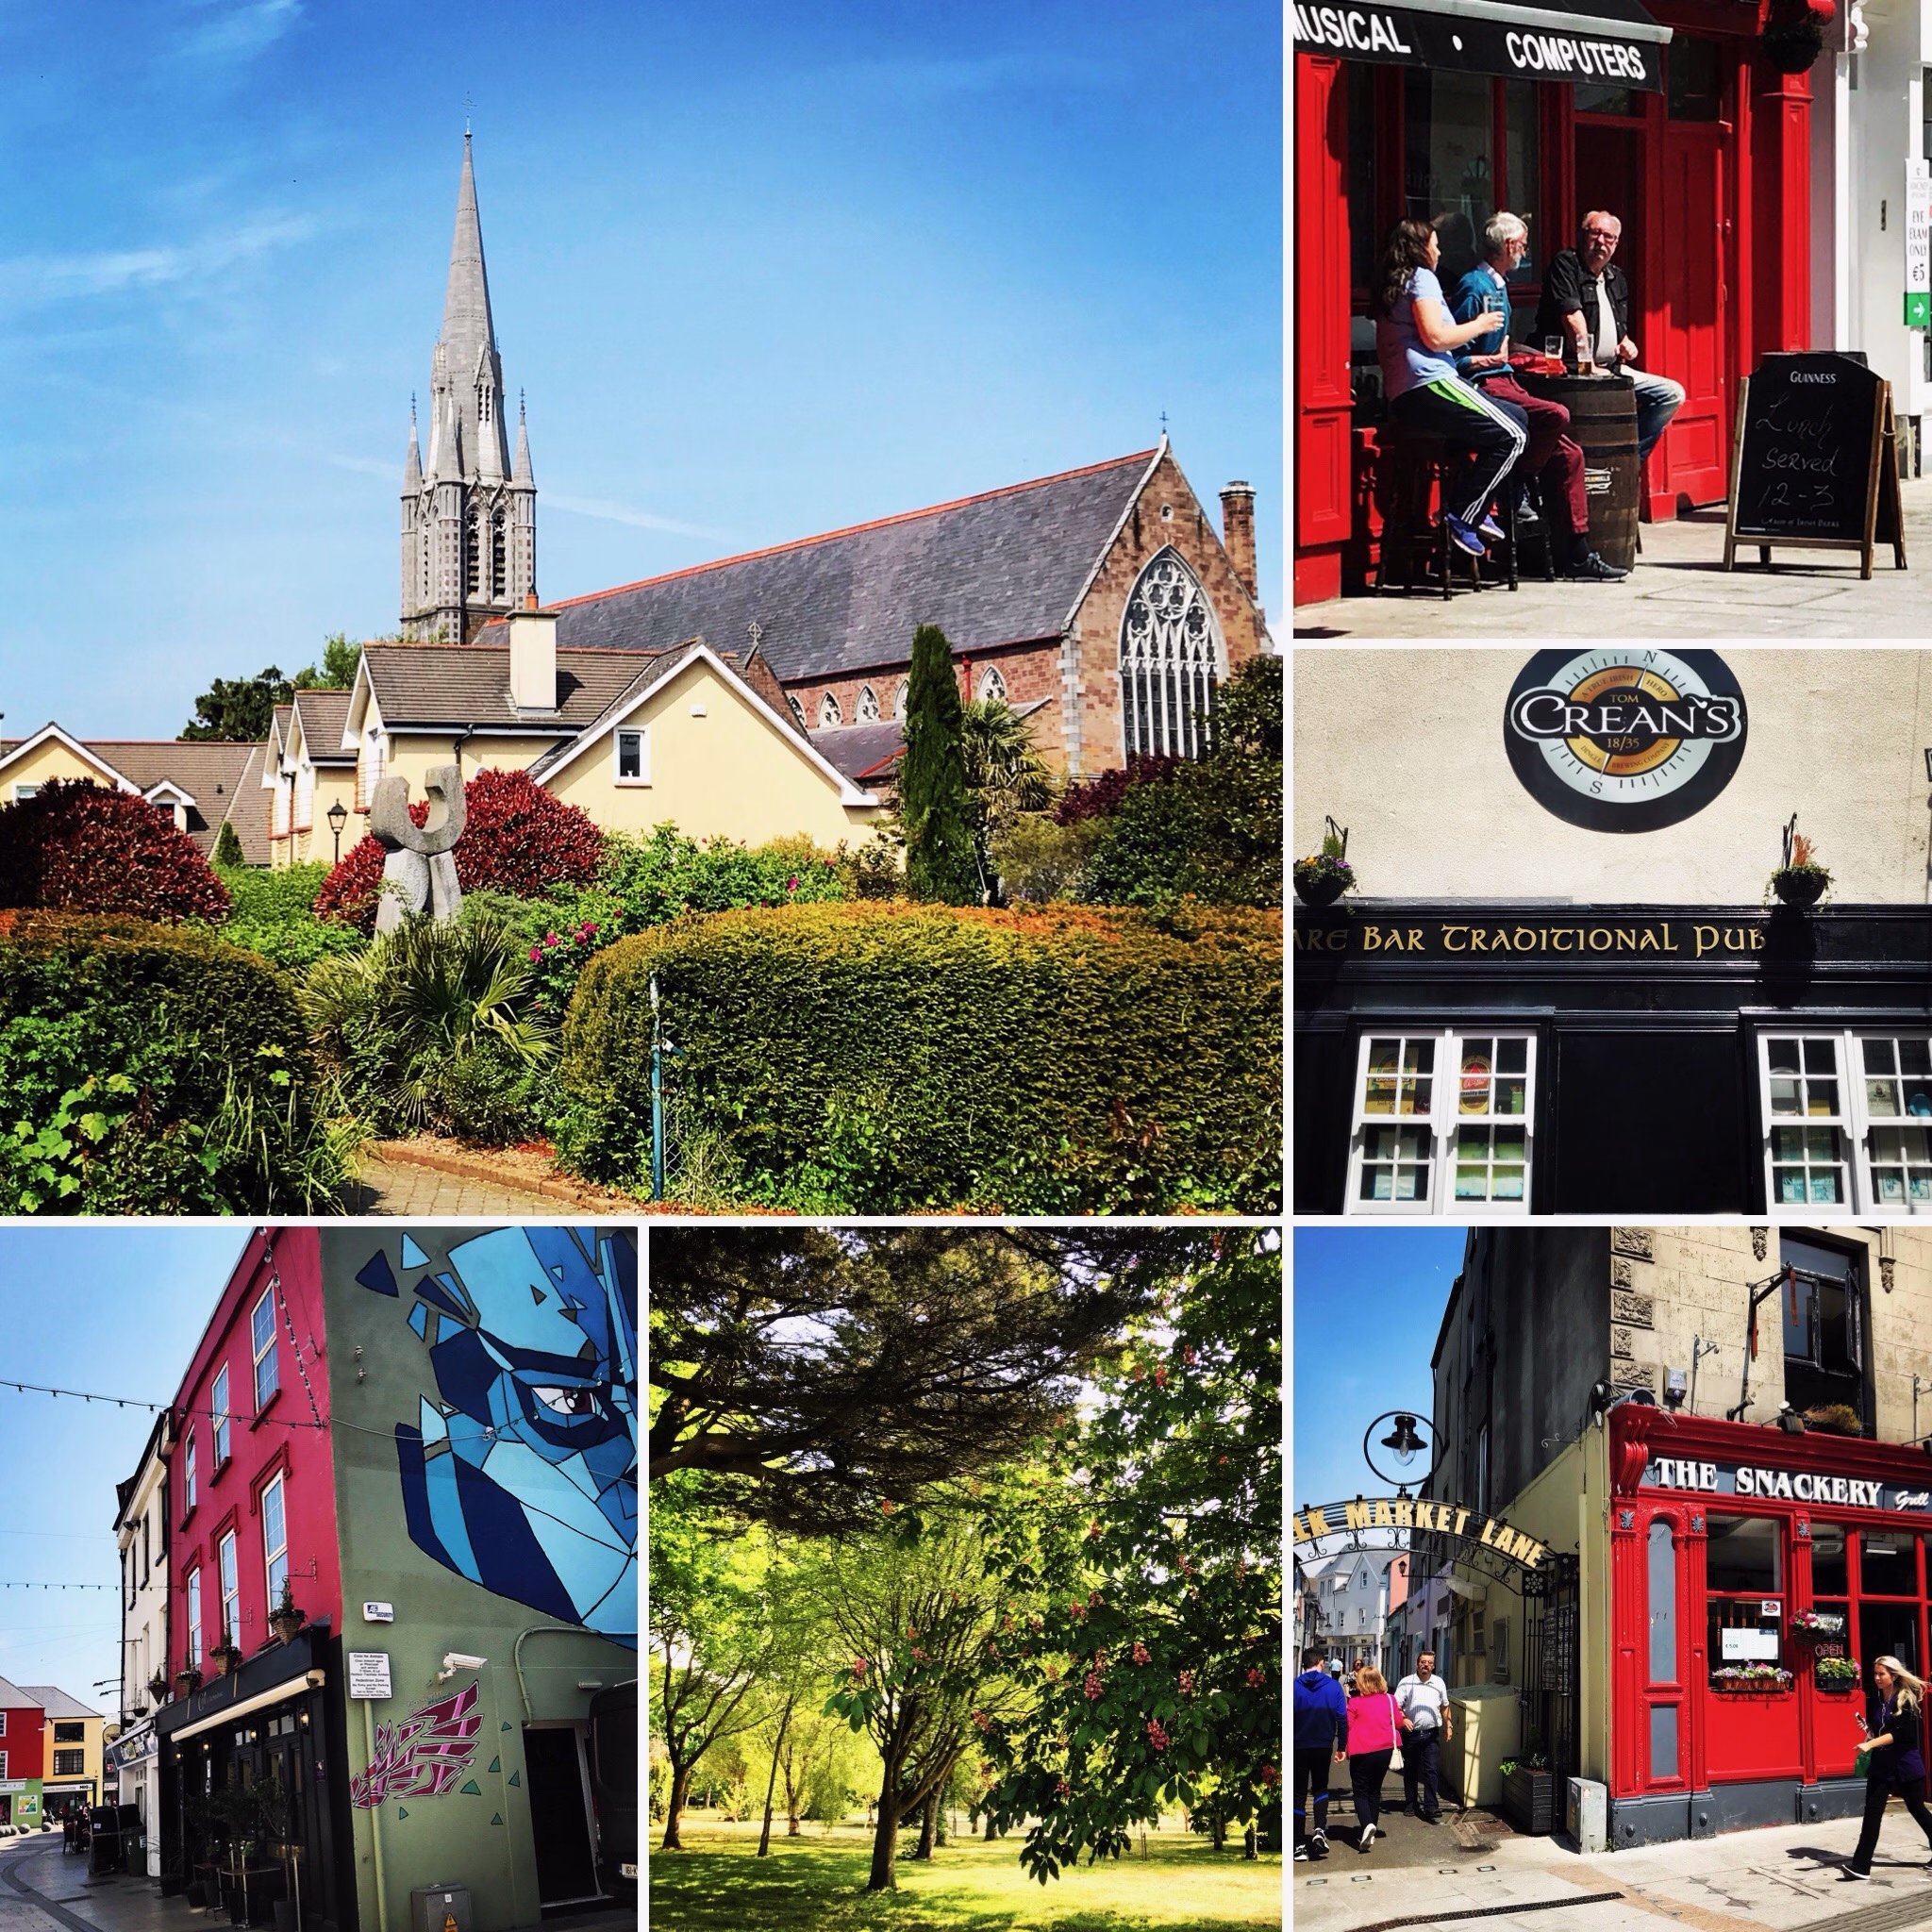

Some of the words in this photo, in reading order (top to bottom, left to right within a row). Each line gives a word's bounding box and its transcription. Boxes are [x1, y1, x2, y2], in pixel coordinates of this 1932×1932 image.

[1506, 31, 1646, 80] COMPUTERS
[1912, 210, 1924, 224] EYE
[1909, 227, 1928, 240] EXAM
[1909, 243, 1927, 257] ONLY
[1912, 263, 1925, 281] €5
[1790, 371, 1837, 384] GUINNESS
[1755, 394, 1834, 449] Lunch
[1642, 650, 1658, 663] N
[1587, 678, 1607, 692] TRUE
[1609, 675, 1634, 683] IRISH
[1646, 679, 1668, 697] HERO
[1609, 694, 1640, 704] TOM
[1607, 736, 1641, 752] 18/35
[1580, 745, 1602, 763] DINGLE
[1611, 759, 1643, 768] BREWING
[1643, 742, 1671, 763] COMPANY
[1589, 780, 1604, 794] S
[1655, 1457, 1719, 1491] THE
[1736, 1466, 1884, 1507] SNACKERY
[1345, 1499, 1471, 1535] MARKET
[1480, 1518, 1546, 1568] LANE
[1815, 1643, 1843, 1657] OPEN
